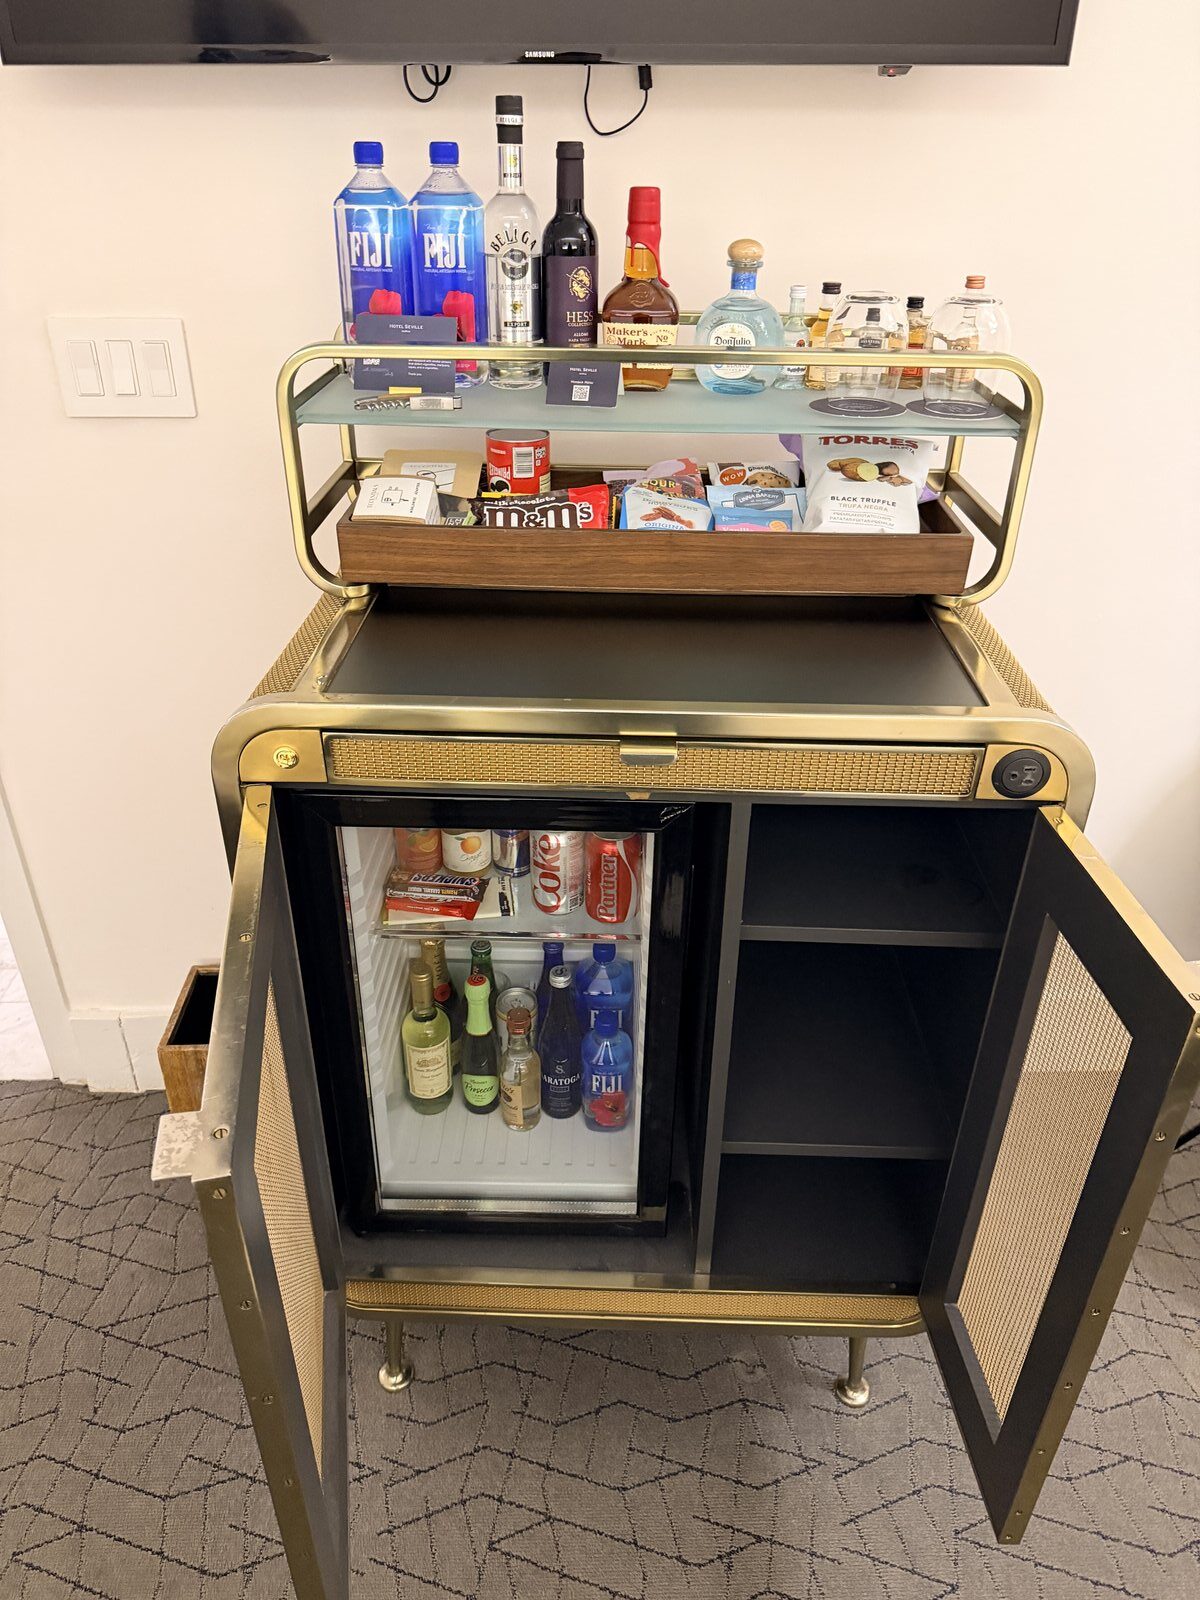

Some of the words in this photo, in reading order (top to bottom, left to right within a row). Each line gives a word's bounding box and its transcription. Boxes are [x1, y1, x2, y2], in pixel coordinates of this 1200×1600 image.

[348, 231, 393, 268] FIJI
[423, 232, 467, 269] FIJI
[566, 311, 593, 323] HESS
[606, 327, 648, 336] Maker's
[819, 435, 919, 449] TORRES
[722, 471, 744, 482] WOW
[641, 479, 676, 489] SOUR
[509, 496, 557, 506] chocolate
[860, 497, 897, 507] TRUFFLE
[864, 504, 889, 512] NEGRA
[411, 873, 479, 887] SNICKERS
[533, 834, 561, 914] Coke
[597, 853, 618, 922] Partner
[590, 1009, 623, 1029] FI
[542, 1073, 580, 1086] ARATOGA
[591, 1074, 623, 1093] FIJI
[464, 1081, 495, 1094] Prosecco
